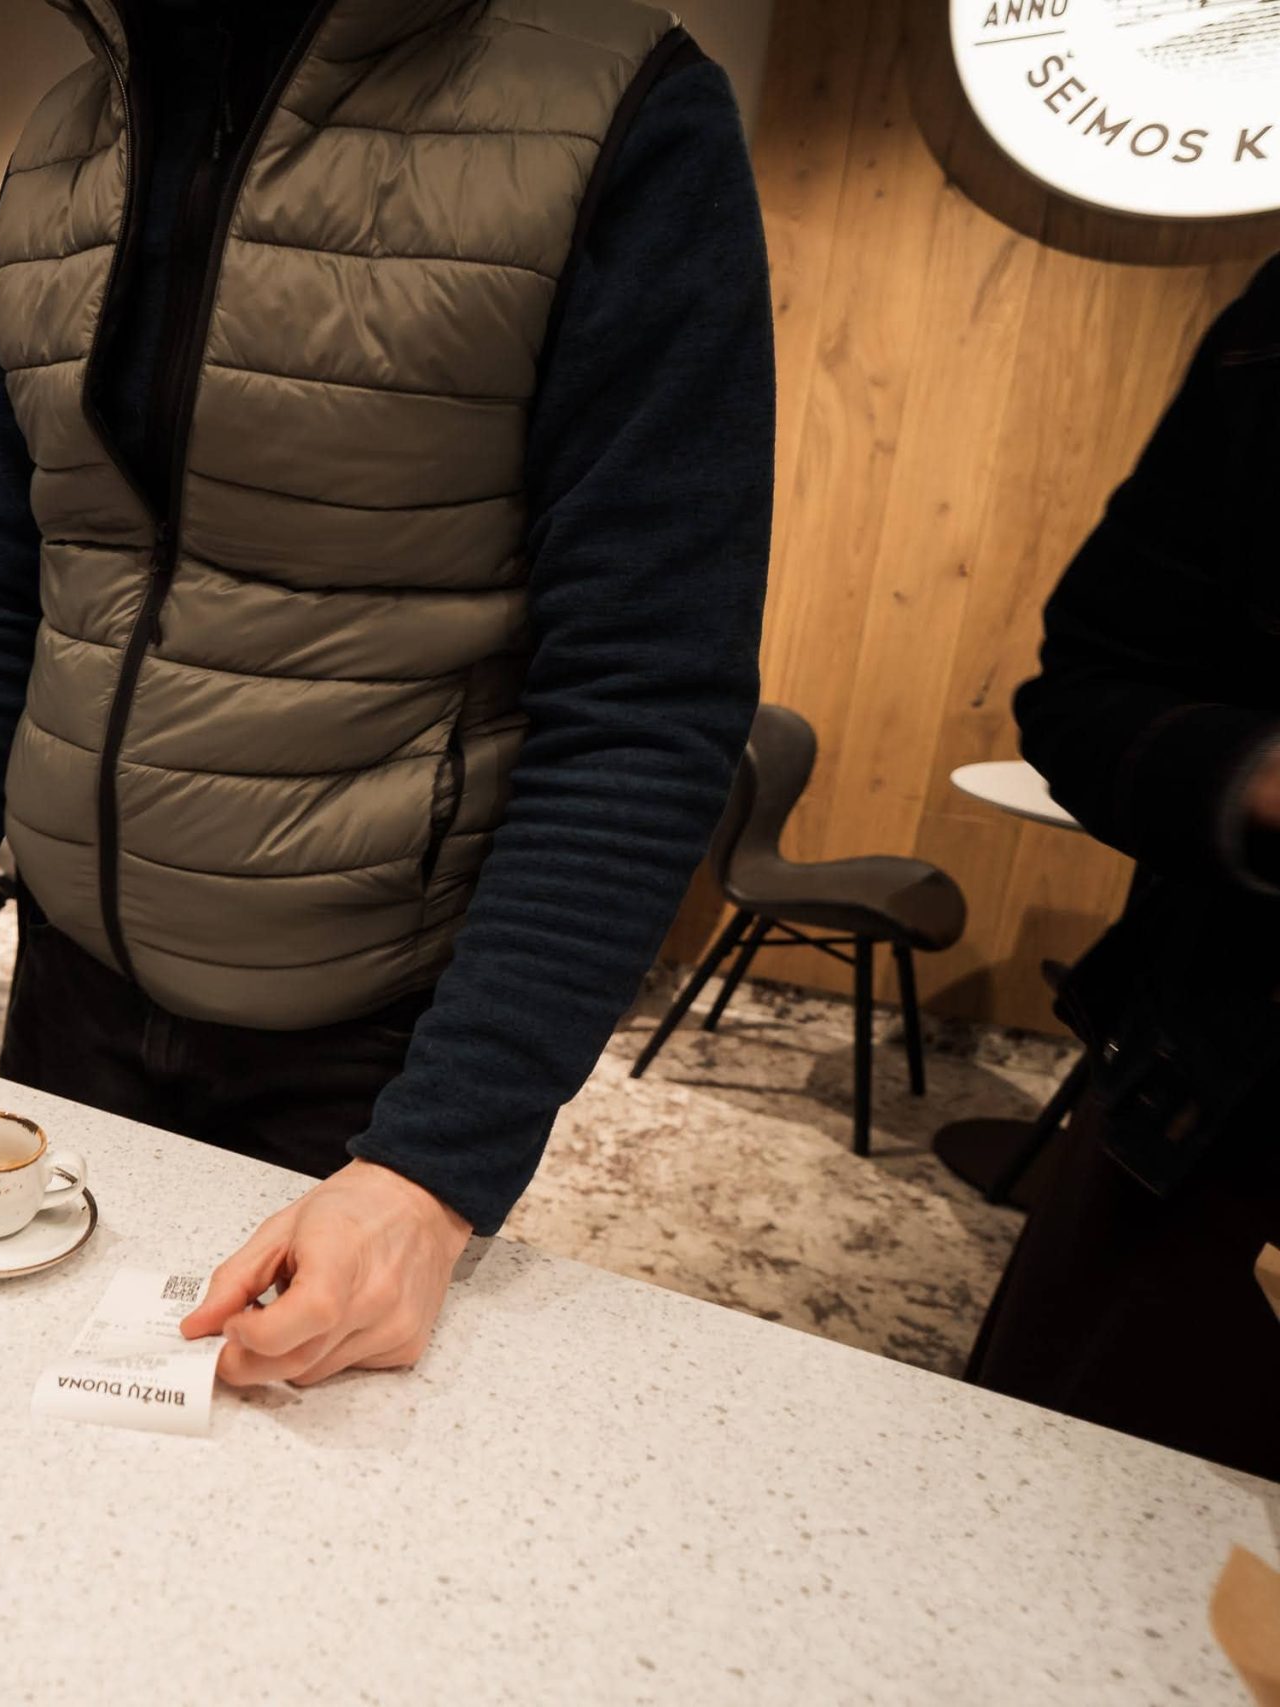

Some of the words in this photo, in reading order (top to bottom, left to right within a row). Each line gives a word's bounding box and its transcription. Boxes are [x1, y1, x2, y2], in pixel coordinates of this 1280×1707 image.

[1026, 50, 1209, 163] ŠEIMOS
[57, 1376, 121, 1396] DUONA
[128, 1382, 186, 1406] BIRŽŲ
